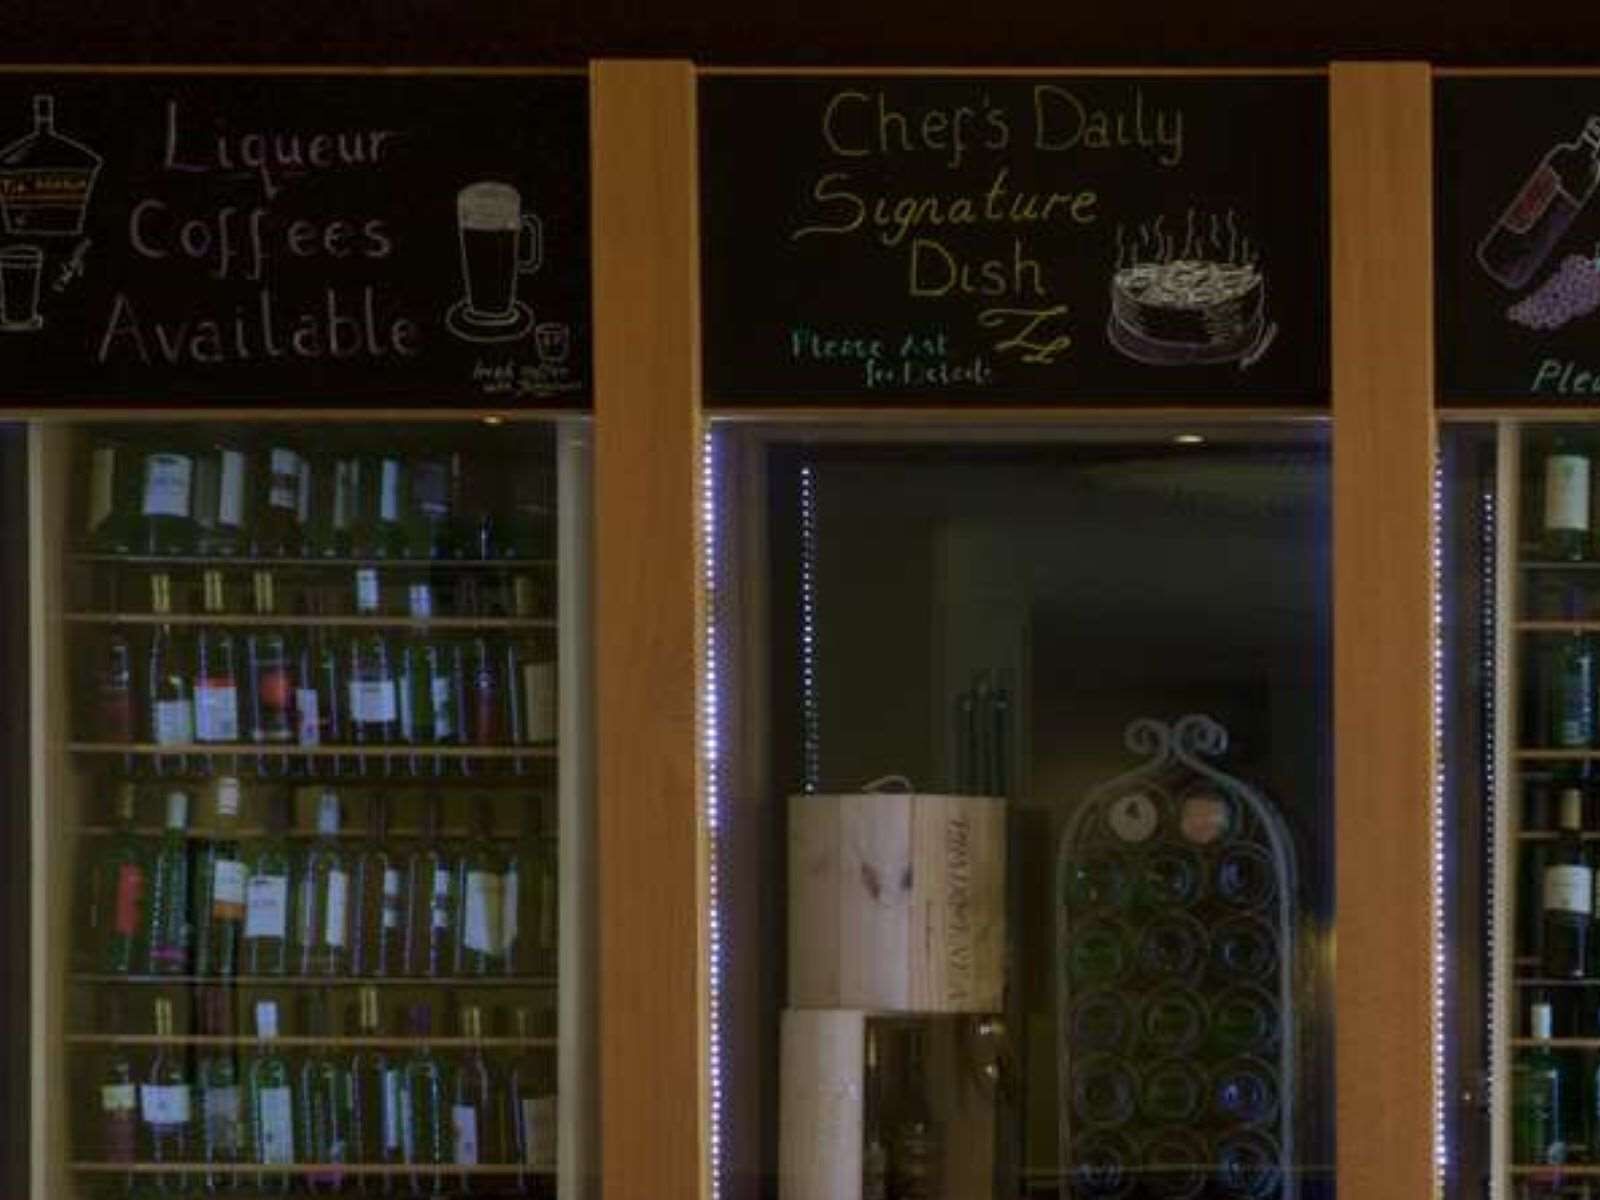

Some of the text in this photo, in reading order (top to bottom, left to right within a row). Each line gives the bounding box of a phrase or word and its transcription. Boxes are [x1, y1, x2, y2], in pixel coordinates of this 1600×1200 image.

[163, 98, 396, 200] Liqueur
[822, 84, 1185, 169] Chef's Daily
[128, 198, 393, 281] Coffees
[793, 168, 1098, 247] Signature
[908, 236, 1046, 298] Dish
[98, 286, 420, 367] Available
